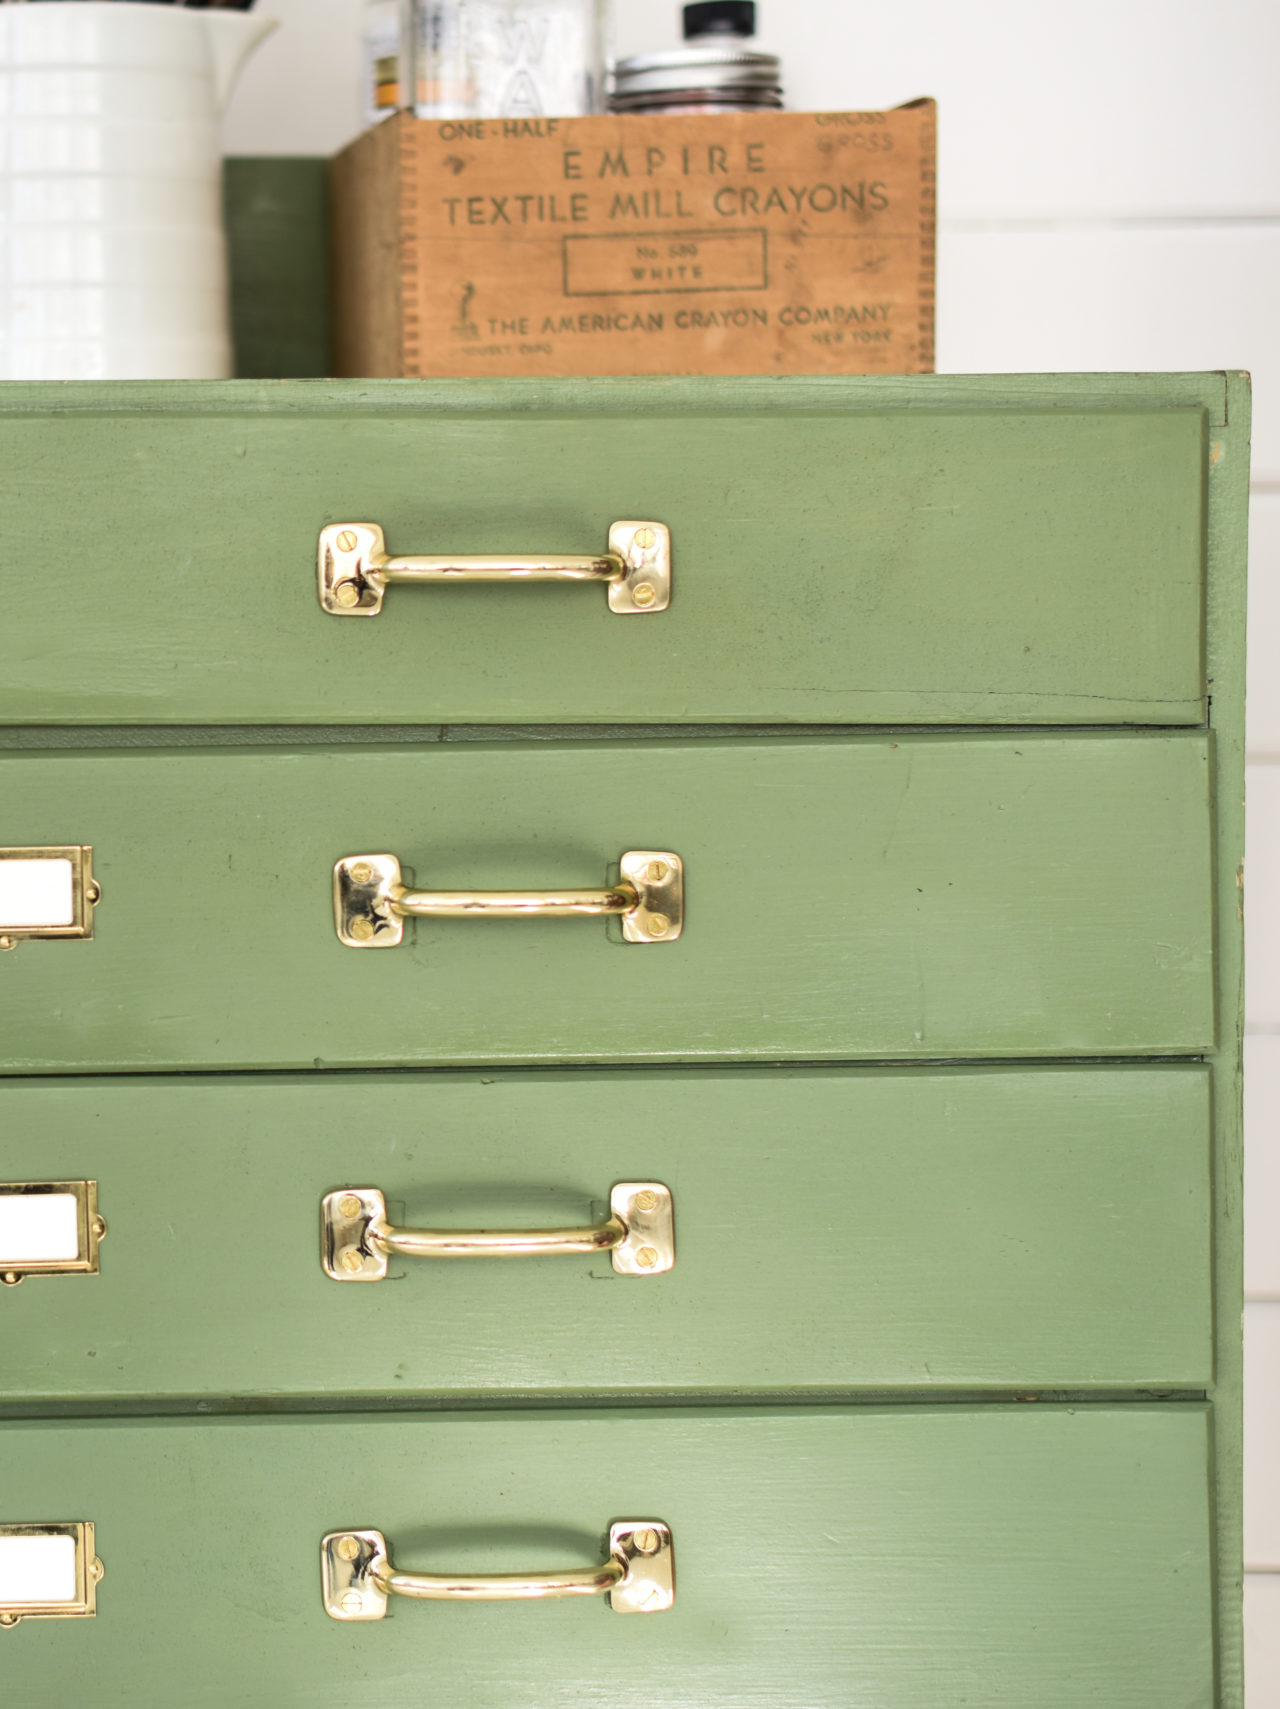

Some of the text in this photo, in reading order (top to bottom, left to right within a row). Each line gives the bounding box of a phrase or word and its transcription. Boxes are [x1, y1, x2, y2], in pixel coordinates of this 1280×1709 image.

[563, 142, 766, 180] EMPIRE
[442, 181, 890, 226] TEXTILE MILL CRAYONS
[631, 265, 703, 281] WHITE
[488, 304, 892, 335] THE AMERICAN CRAYON COMPANY
[812, 329, 893, 345] NEW YORK
